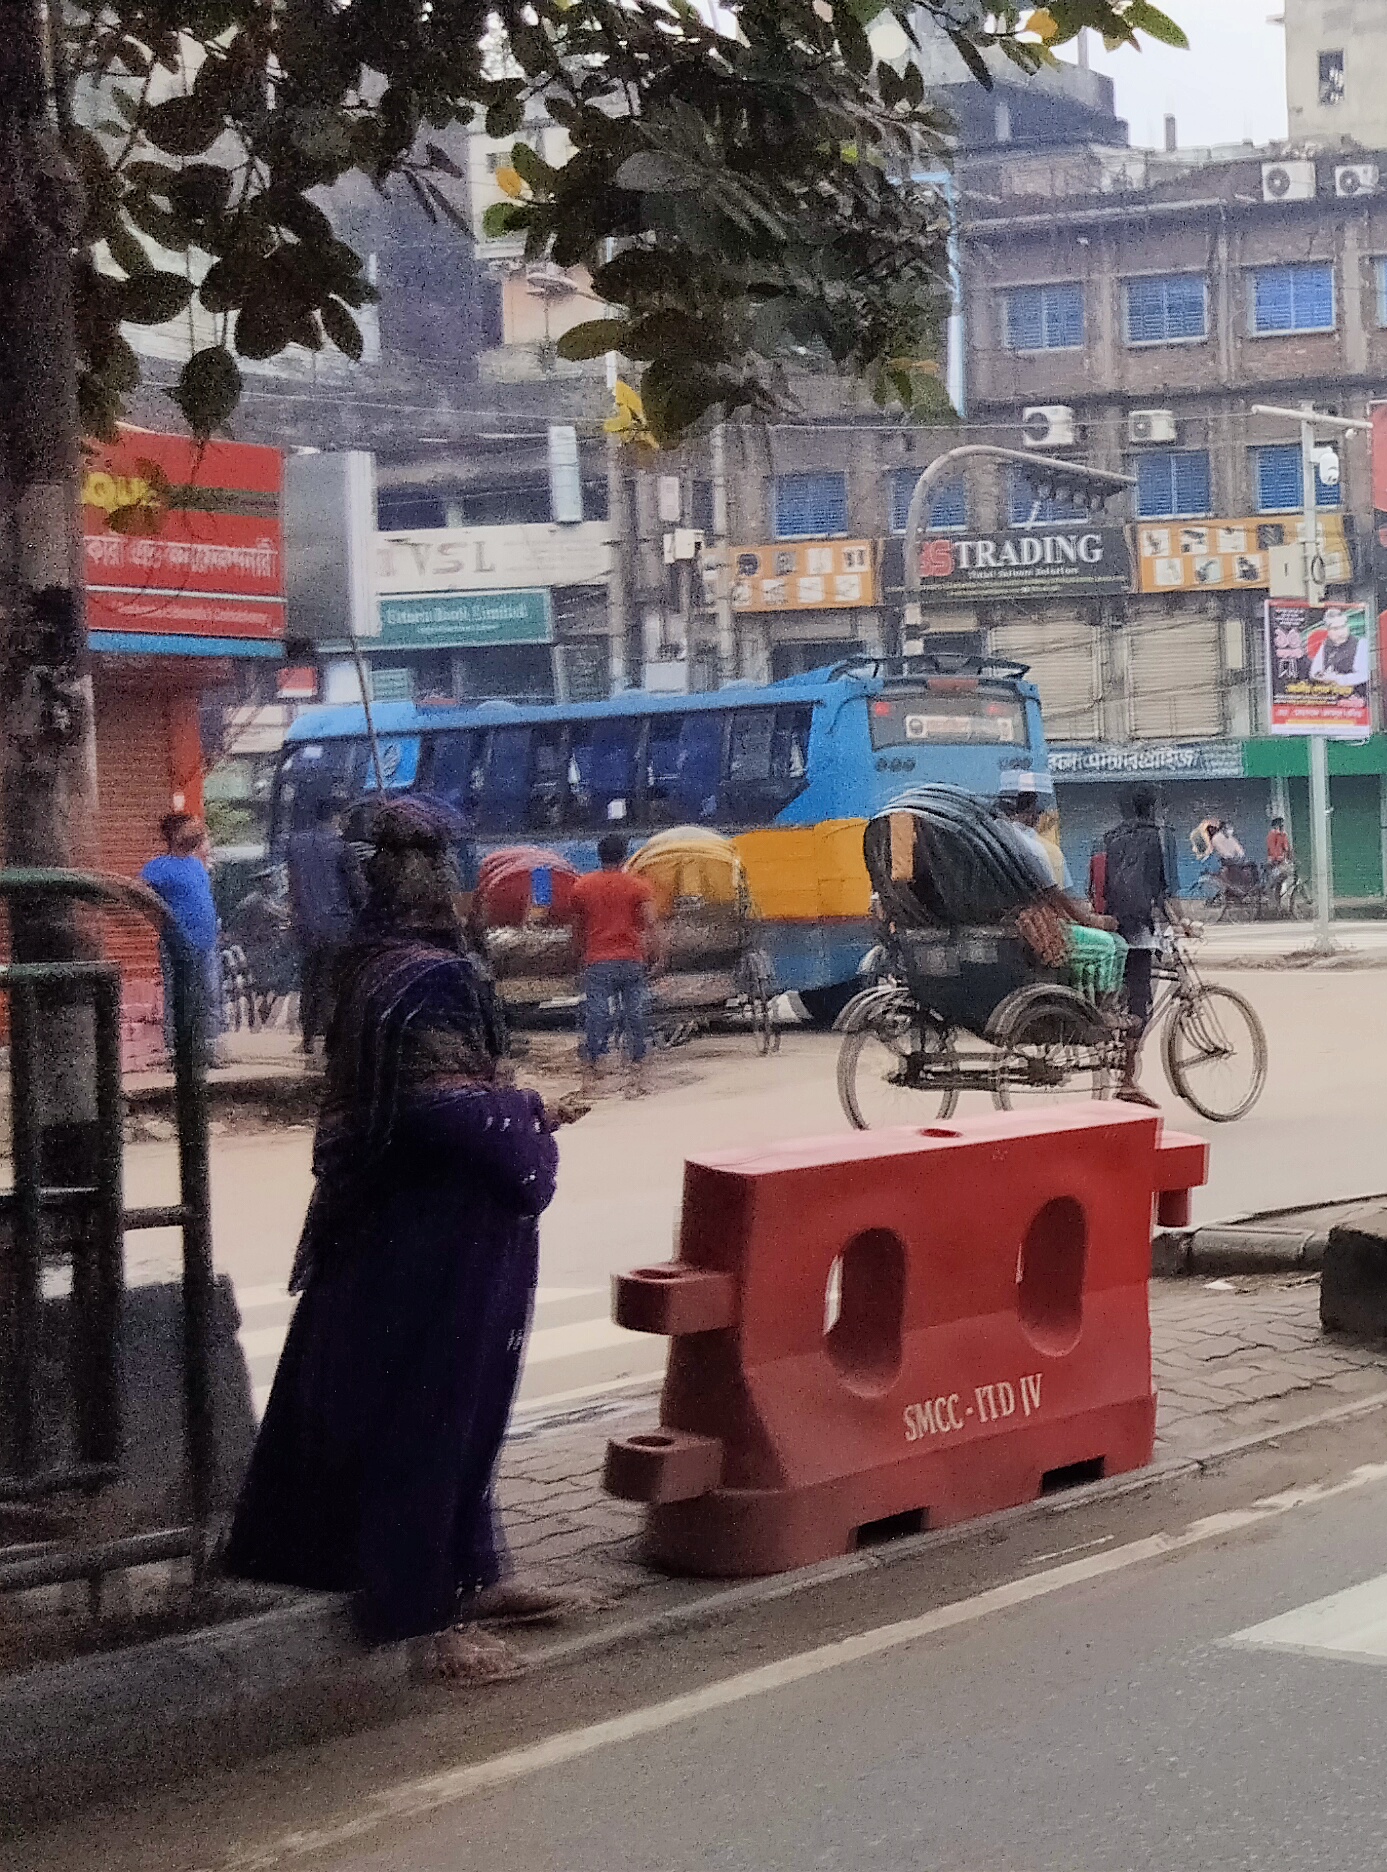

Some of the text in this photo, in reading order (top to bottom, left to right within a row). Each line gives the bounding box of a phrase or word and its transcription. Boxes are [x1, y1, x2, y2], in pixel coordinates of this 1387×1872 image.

[953, 534, 1103, 568] TRADING
[903, 1393, 964, 1441] SMCC
[974, 1381, 1015, 1423] ITD
